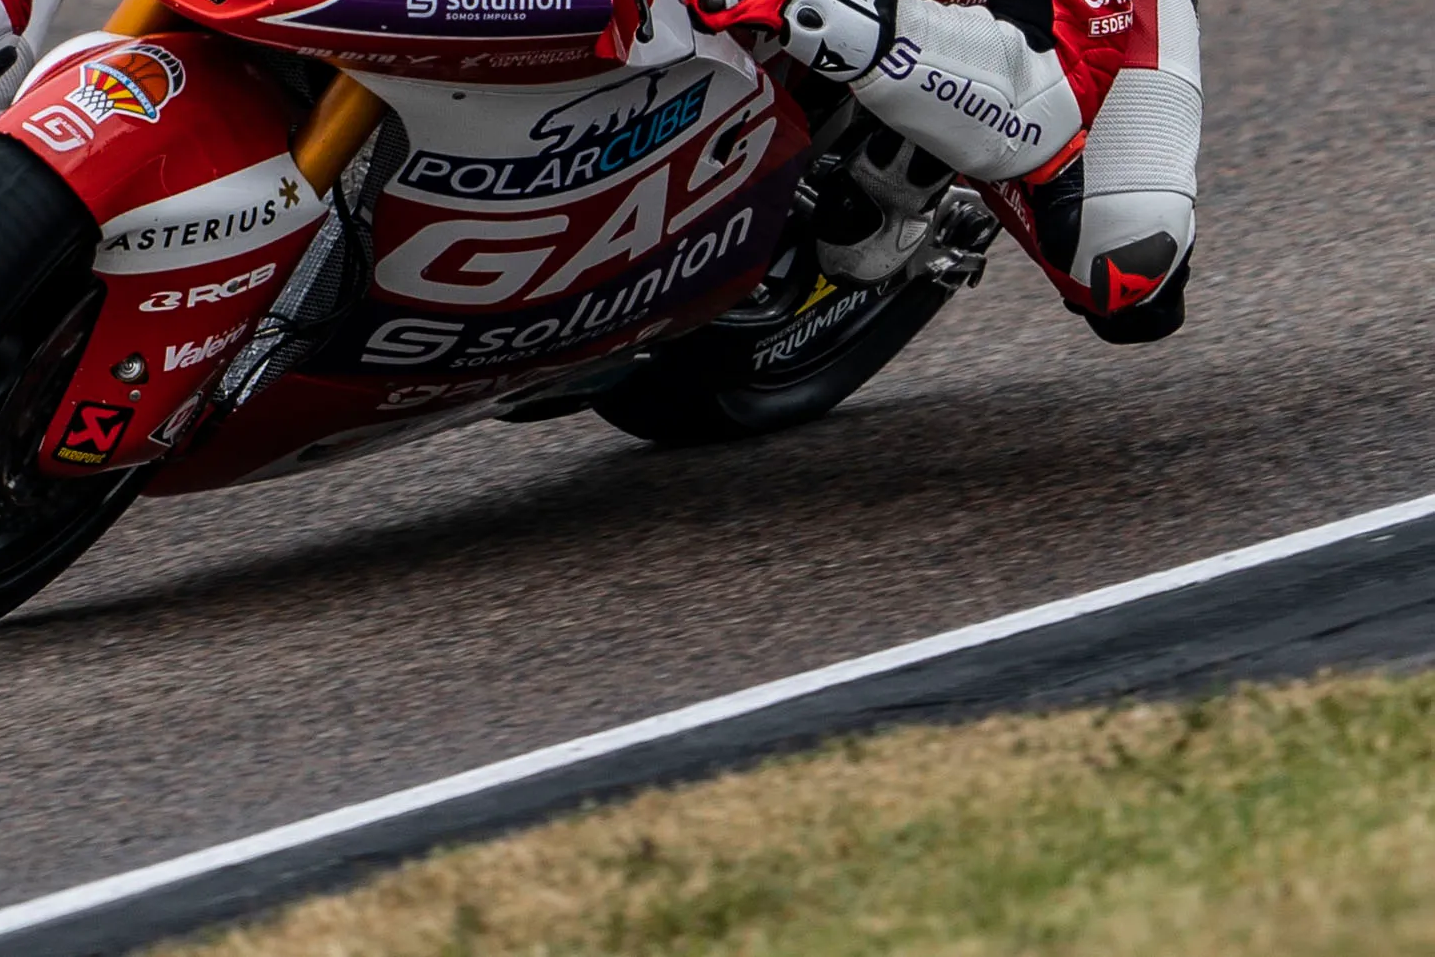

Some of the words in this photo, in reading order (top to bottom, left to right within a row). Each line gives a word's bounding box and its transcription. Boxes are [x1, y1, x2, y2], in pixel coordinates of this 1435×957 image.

[445, 12, 482, 22] SOMOS
[483, 12, 527, 22] IMPULSO
[406, 83, 706, 195] POLARCUBE
[920, 79, 1042, 146] solunion
[105, 199, 277, 254] ASTERIUS
[374, 95, 778, 306] GAS
[464, 206, 754, 355] solunion
[751, 289, 868, 371] TRIUMPH
